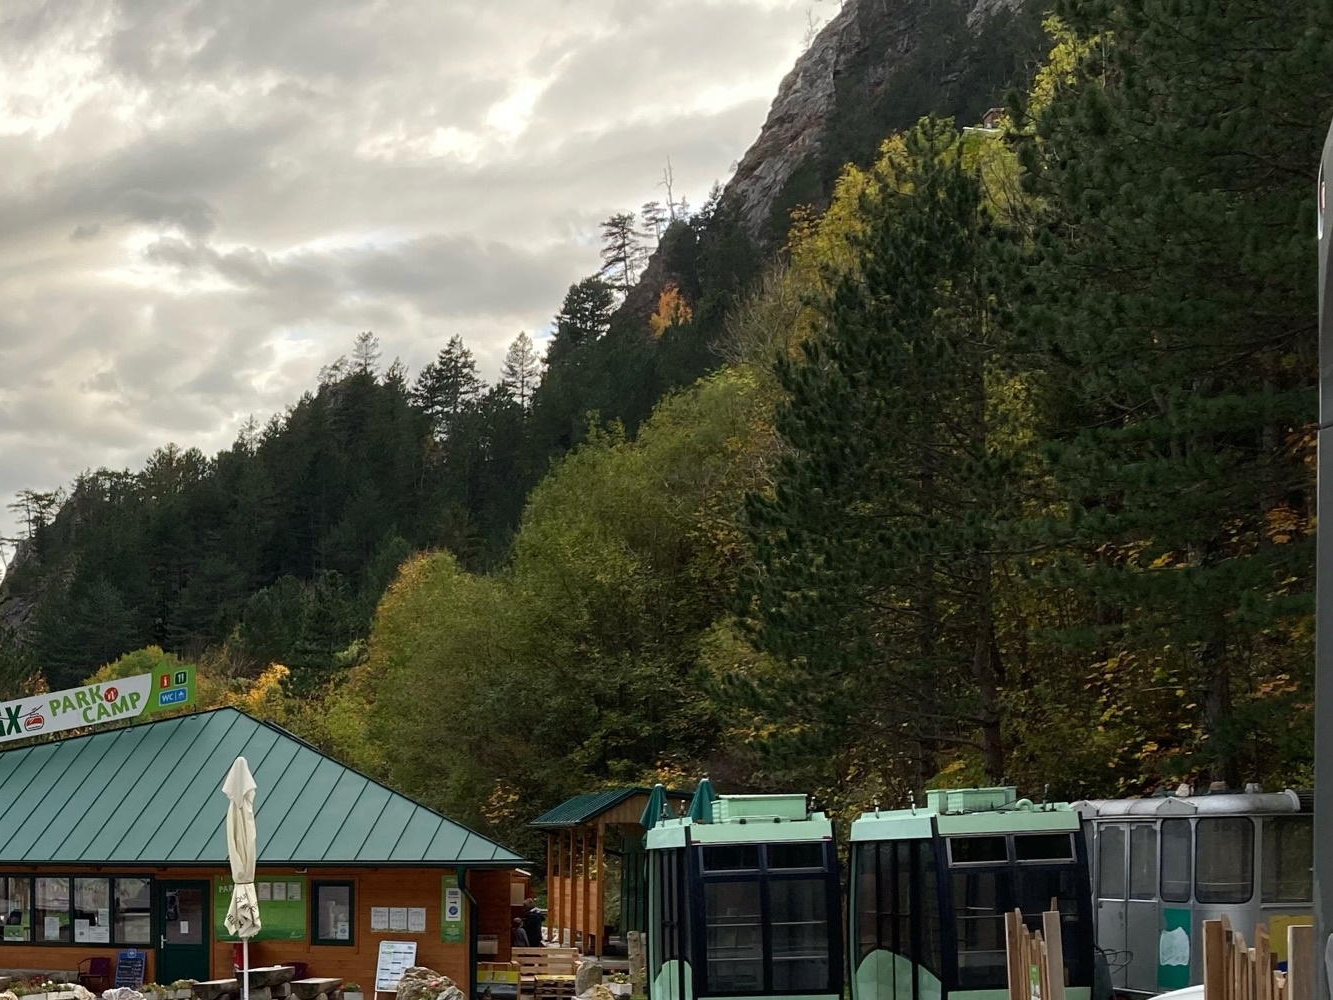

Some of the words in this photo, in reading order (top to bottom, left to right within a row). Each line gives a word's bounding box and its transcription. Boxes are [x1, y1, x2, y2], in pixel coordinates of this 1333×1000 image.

[49, 685, 104, 717] PARK
[83, 692, 140, 723] CAMP
[161, 693, 174, 702] WC
